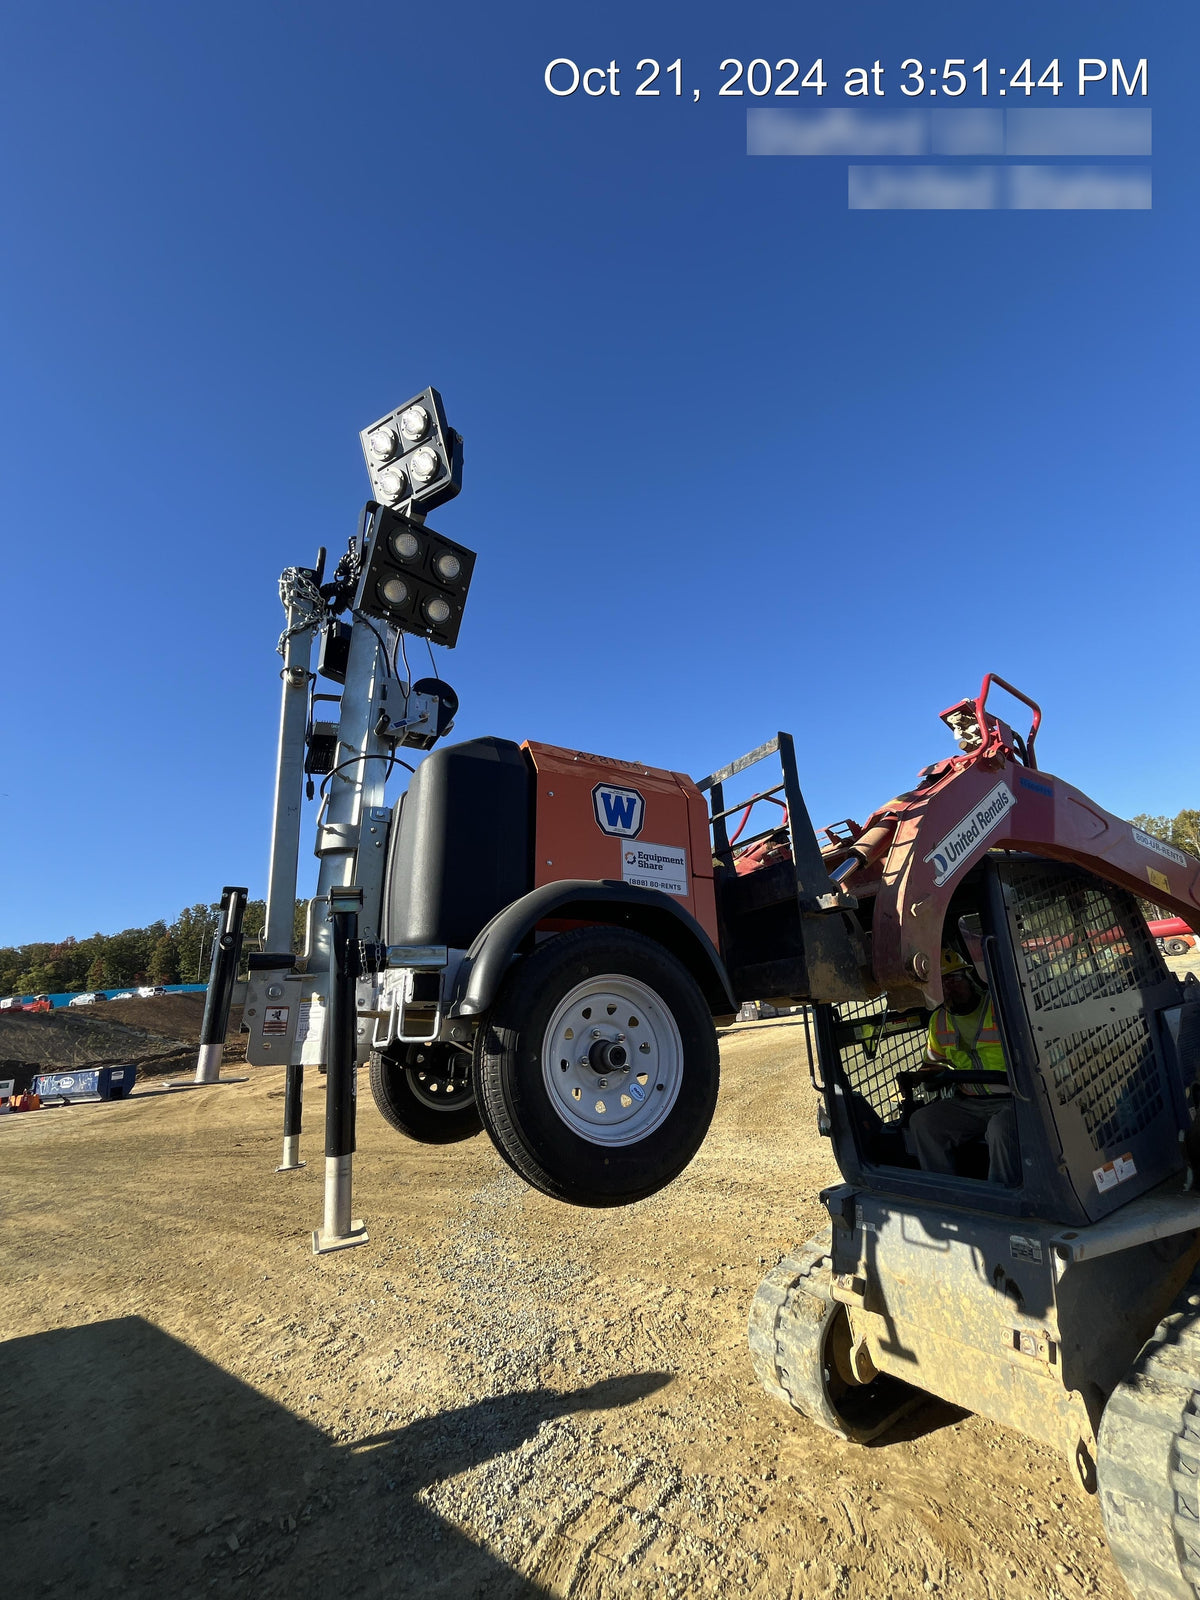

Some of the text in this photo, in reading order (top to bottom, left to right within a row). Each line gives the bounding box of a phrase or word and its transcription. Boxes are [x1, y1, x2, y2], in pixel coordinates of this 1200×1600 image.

[600, 792, 637, 829] W
[944, 792, 1009, 863] United Rentals
[637, 850, 685, 866] Equipment
[637, 860, 664, 871] Share
